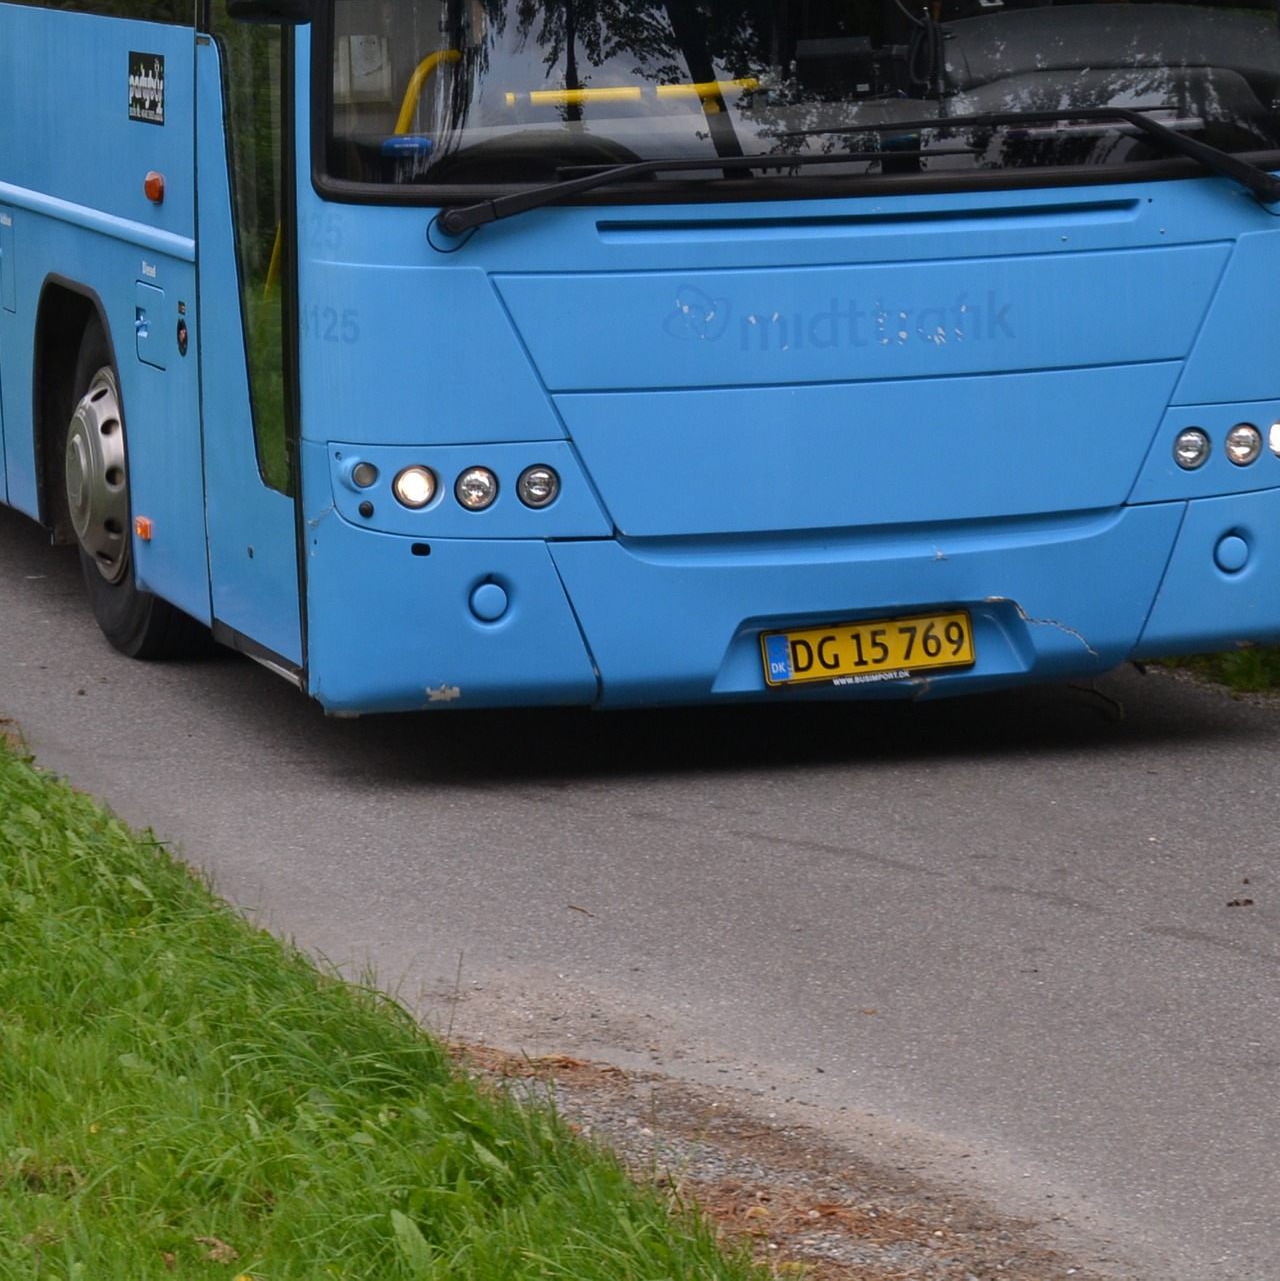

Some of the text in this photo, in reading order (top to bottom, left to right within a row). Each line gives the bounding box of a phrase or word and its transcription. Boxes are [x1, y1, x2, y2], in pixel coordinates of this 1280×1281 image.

[789, 620, 965, 673] DG 15 769
[770, 661, 787, 674] DK
